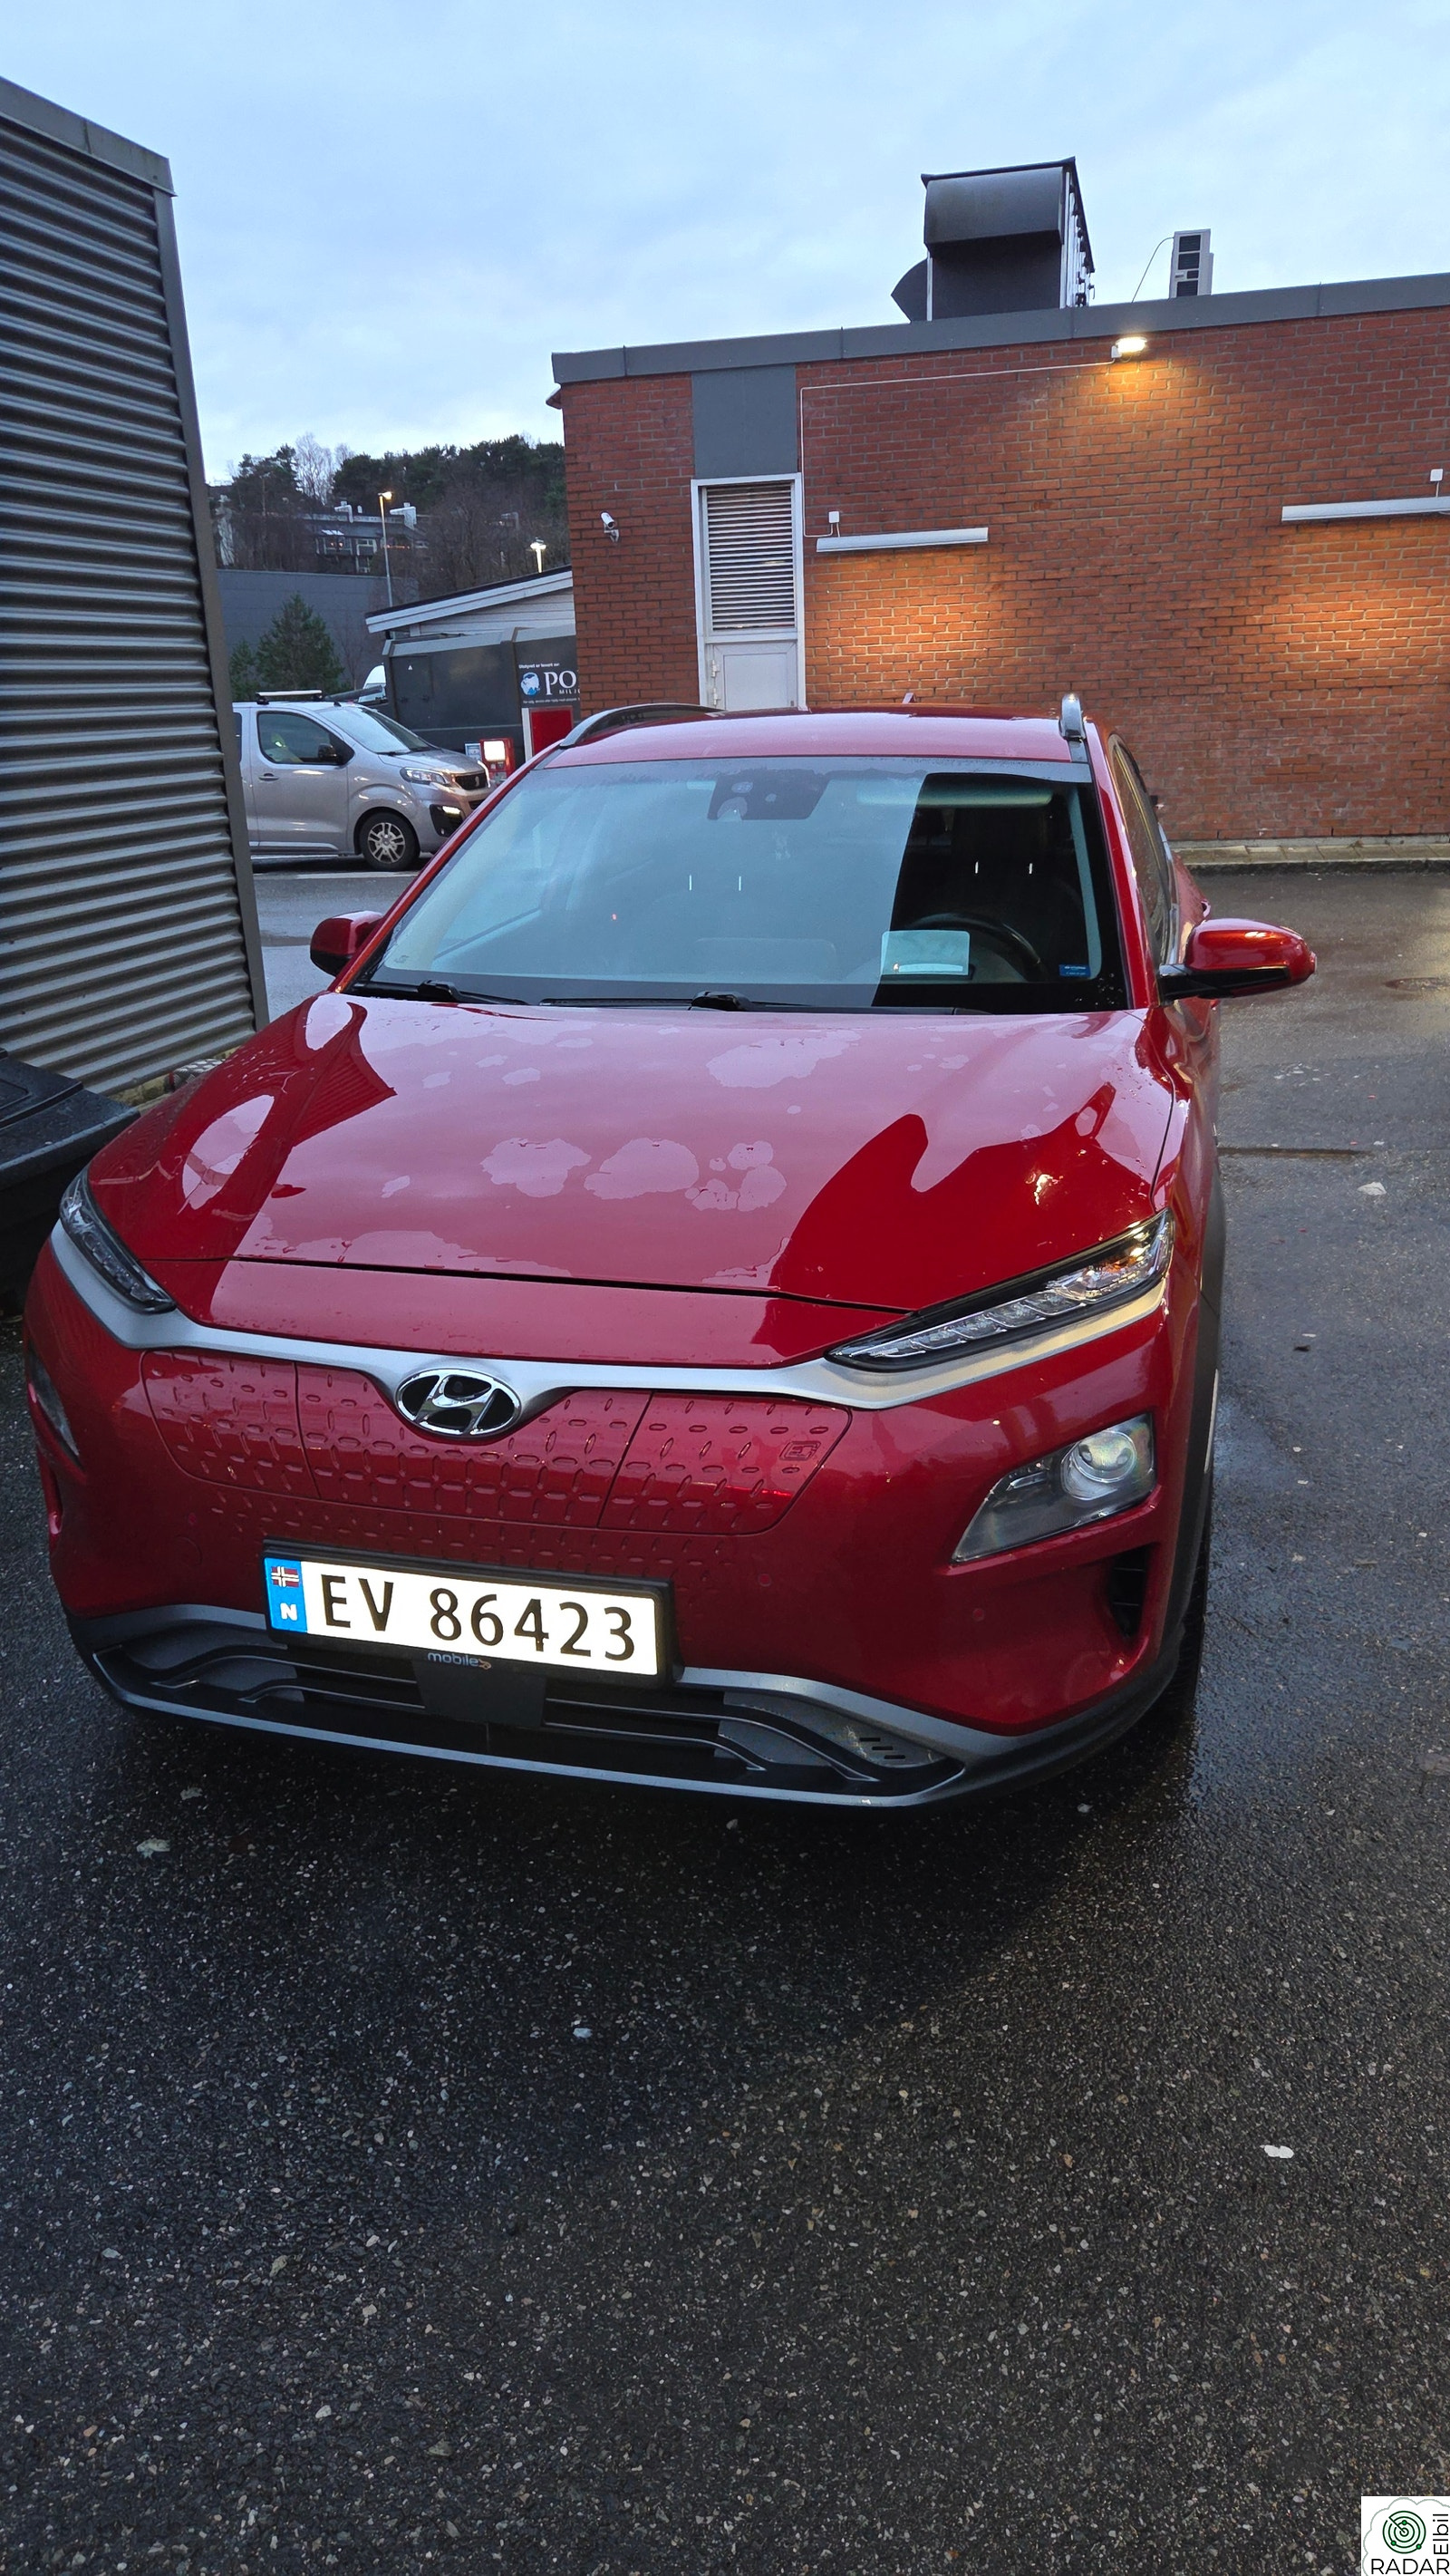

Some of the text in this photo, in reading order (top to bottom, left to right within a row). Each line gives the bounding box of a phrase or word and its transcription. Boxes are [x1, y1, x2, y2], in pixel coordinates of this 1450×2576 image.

[544, 670, 579, 695] PO
[280, 1603, 298, 1621] N
[321, 1574, 634, 1661] EV 86423
